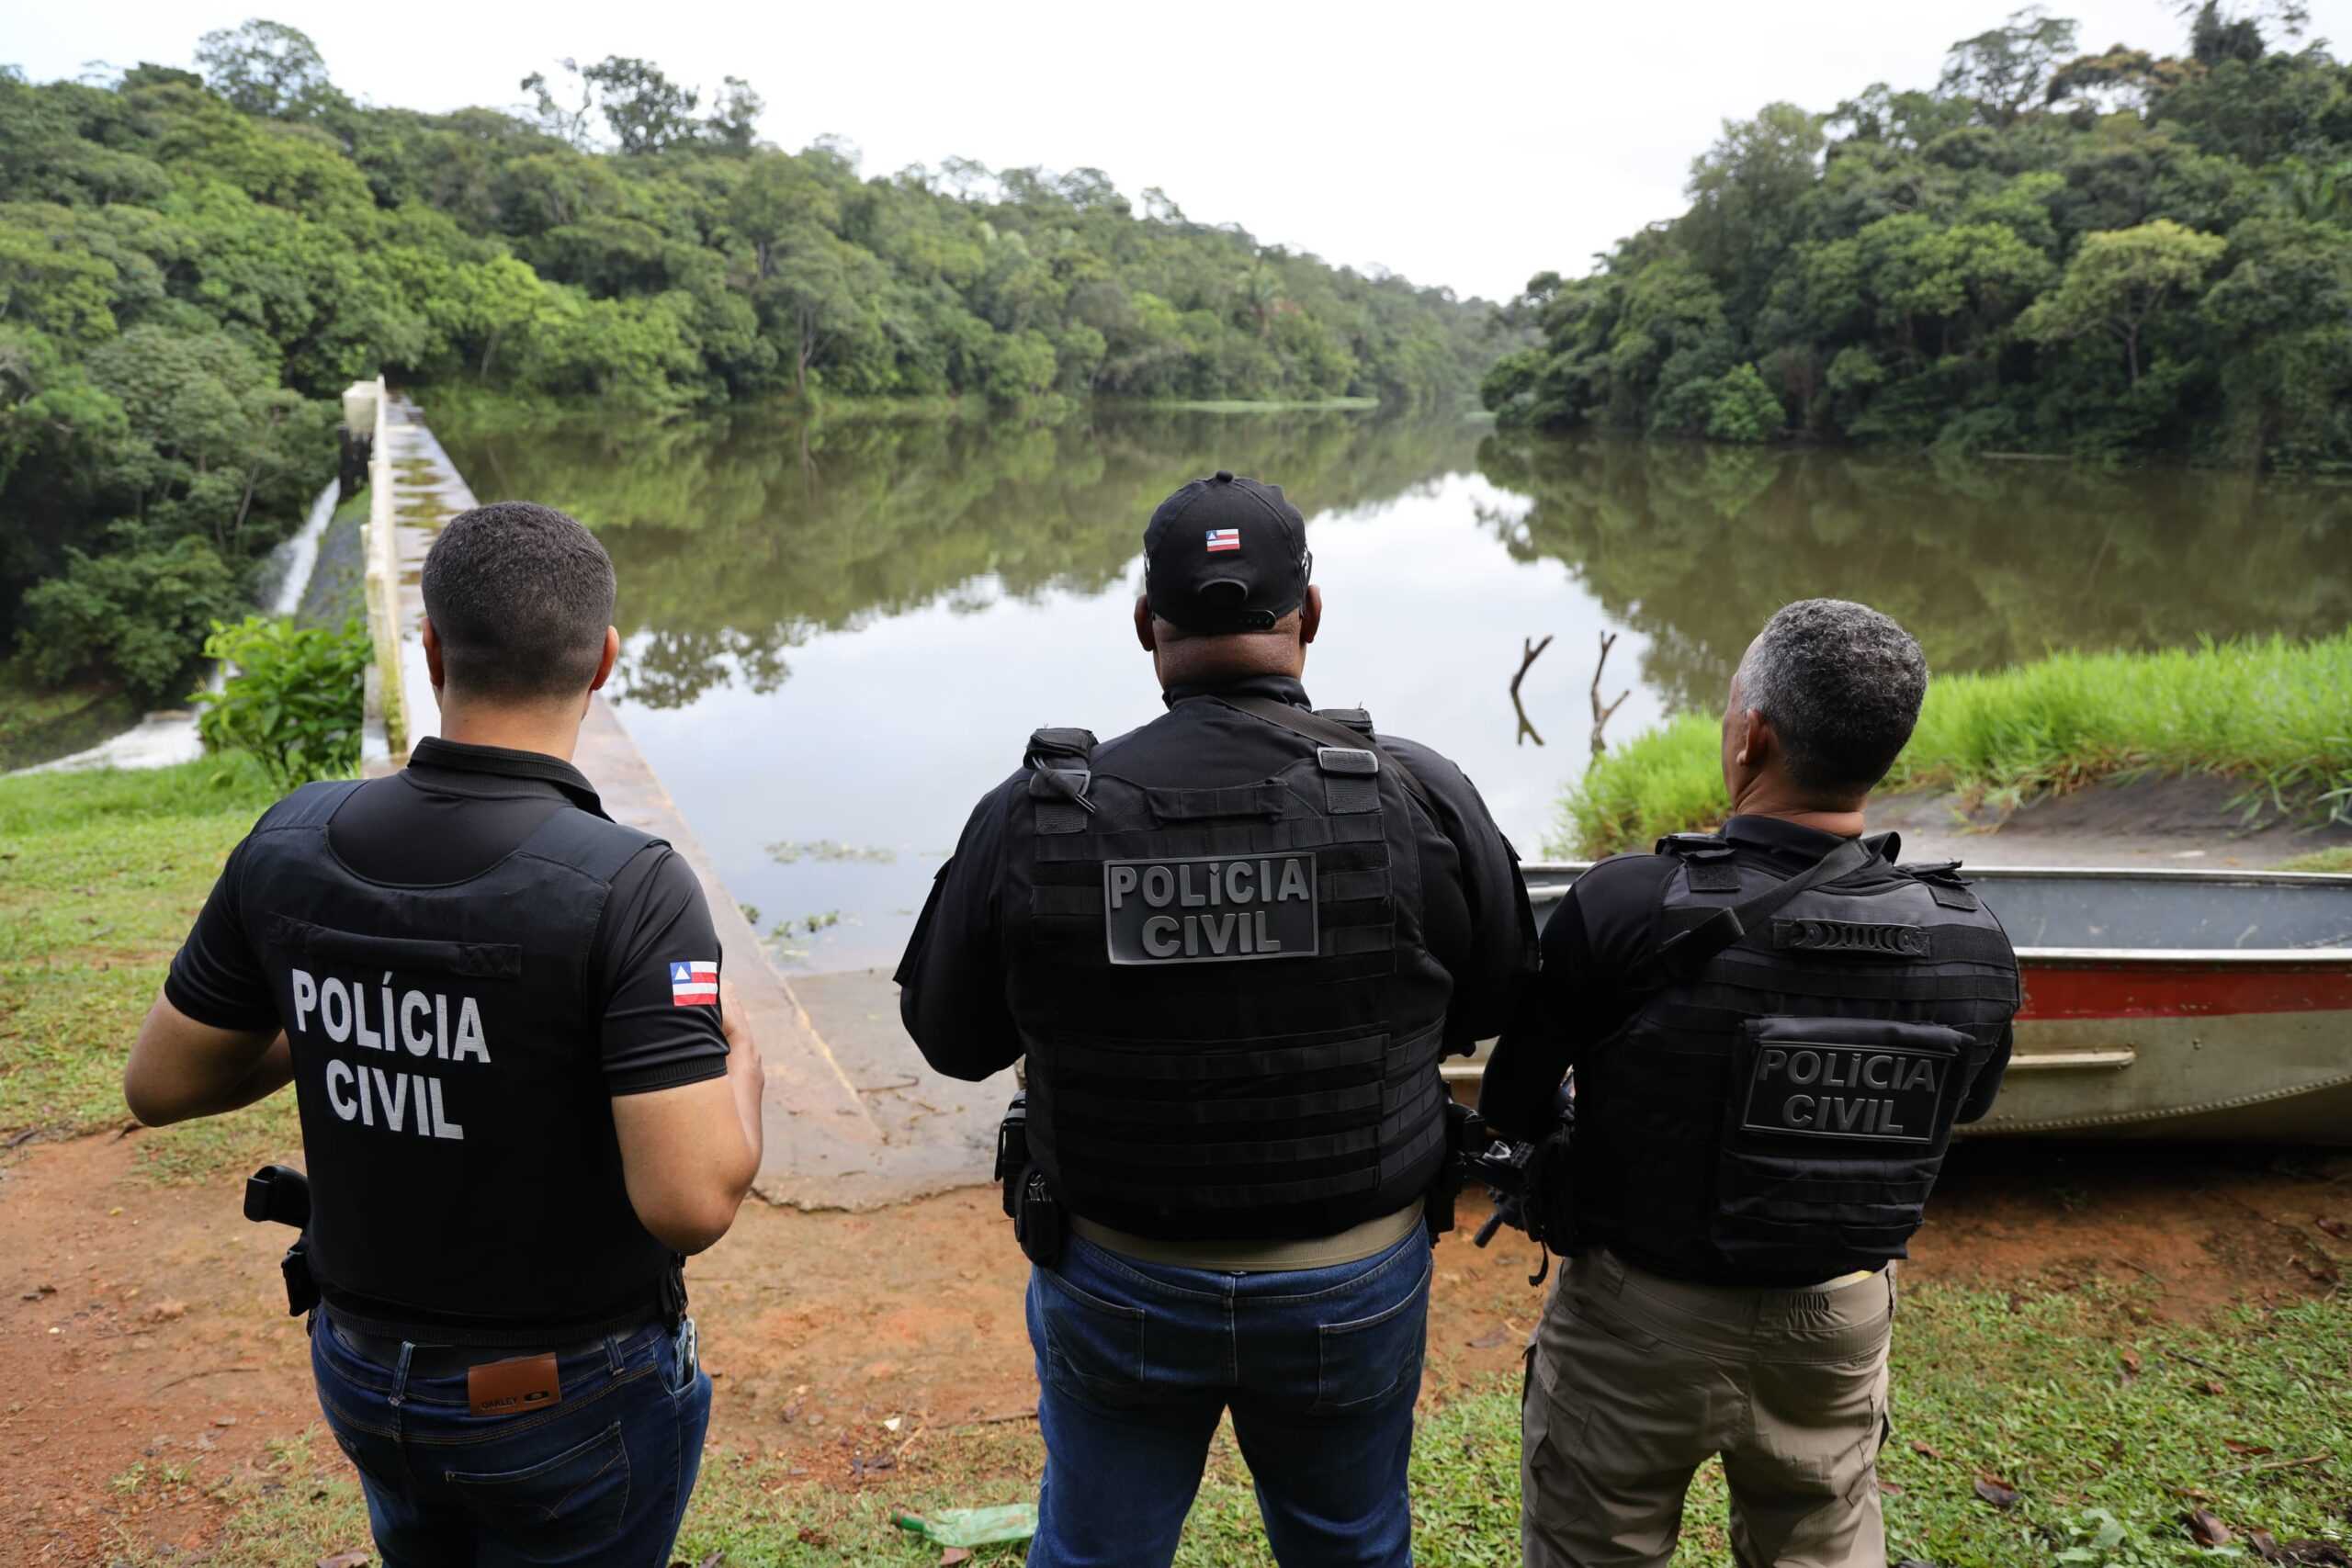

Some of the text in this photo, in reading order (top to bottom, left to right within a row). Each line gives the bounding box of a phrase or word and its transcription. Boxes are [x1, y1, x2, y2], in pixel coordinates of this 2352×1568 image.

[1110, 859, 1309, 908] POLÍCIA
[1142, 910, 1281, 957] CIVIL
[292, 968, 492, 1063] POLÍCIA
[1757, 1049, 1936, 1092] POLÍCIA
[326, 1058, 464, 1140] CIVIL
[1782, 1094, 1904, 1134] CIVIL
